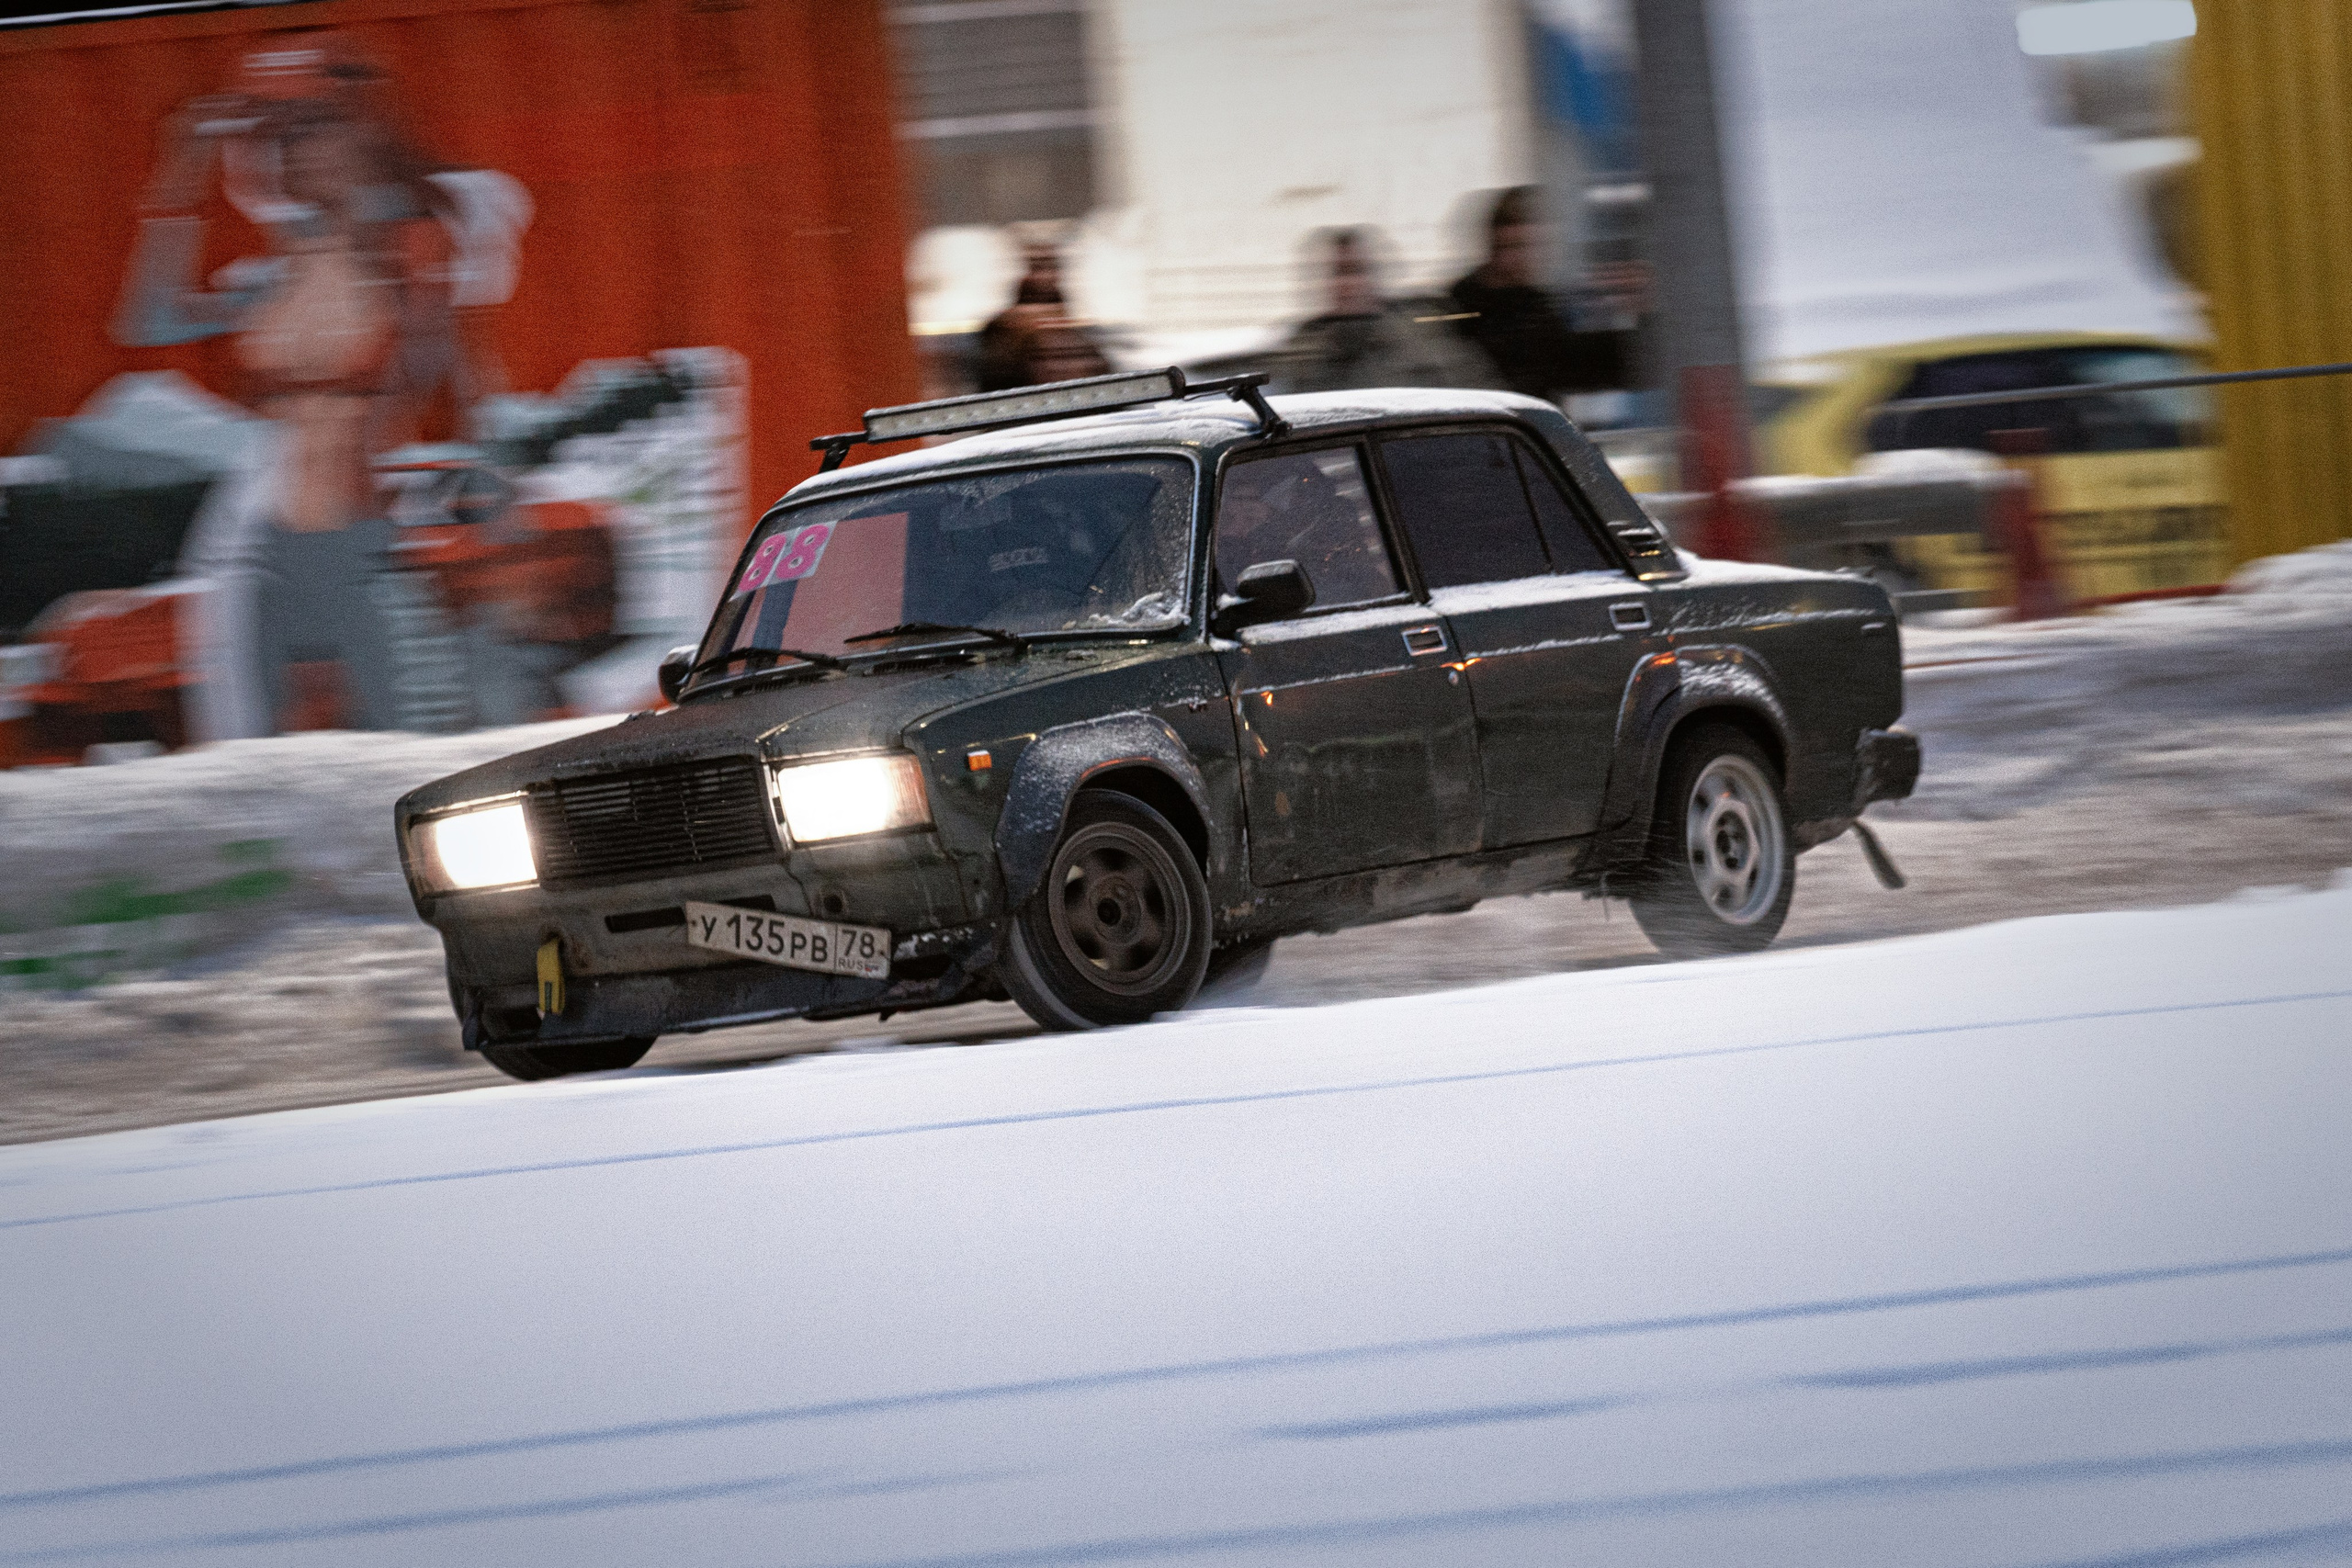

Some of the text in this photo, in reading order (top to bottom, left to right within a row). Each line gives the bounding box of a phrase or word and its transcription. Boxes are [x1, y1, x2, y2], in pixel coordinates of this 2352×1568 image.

[737, 524, 829, 592] 88
[841, 929, 876, 959] 78
[838, 958, 864, 972] RUS
